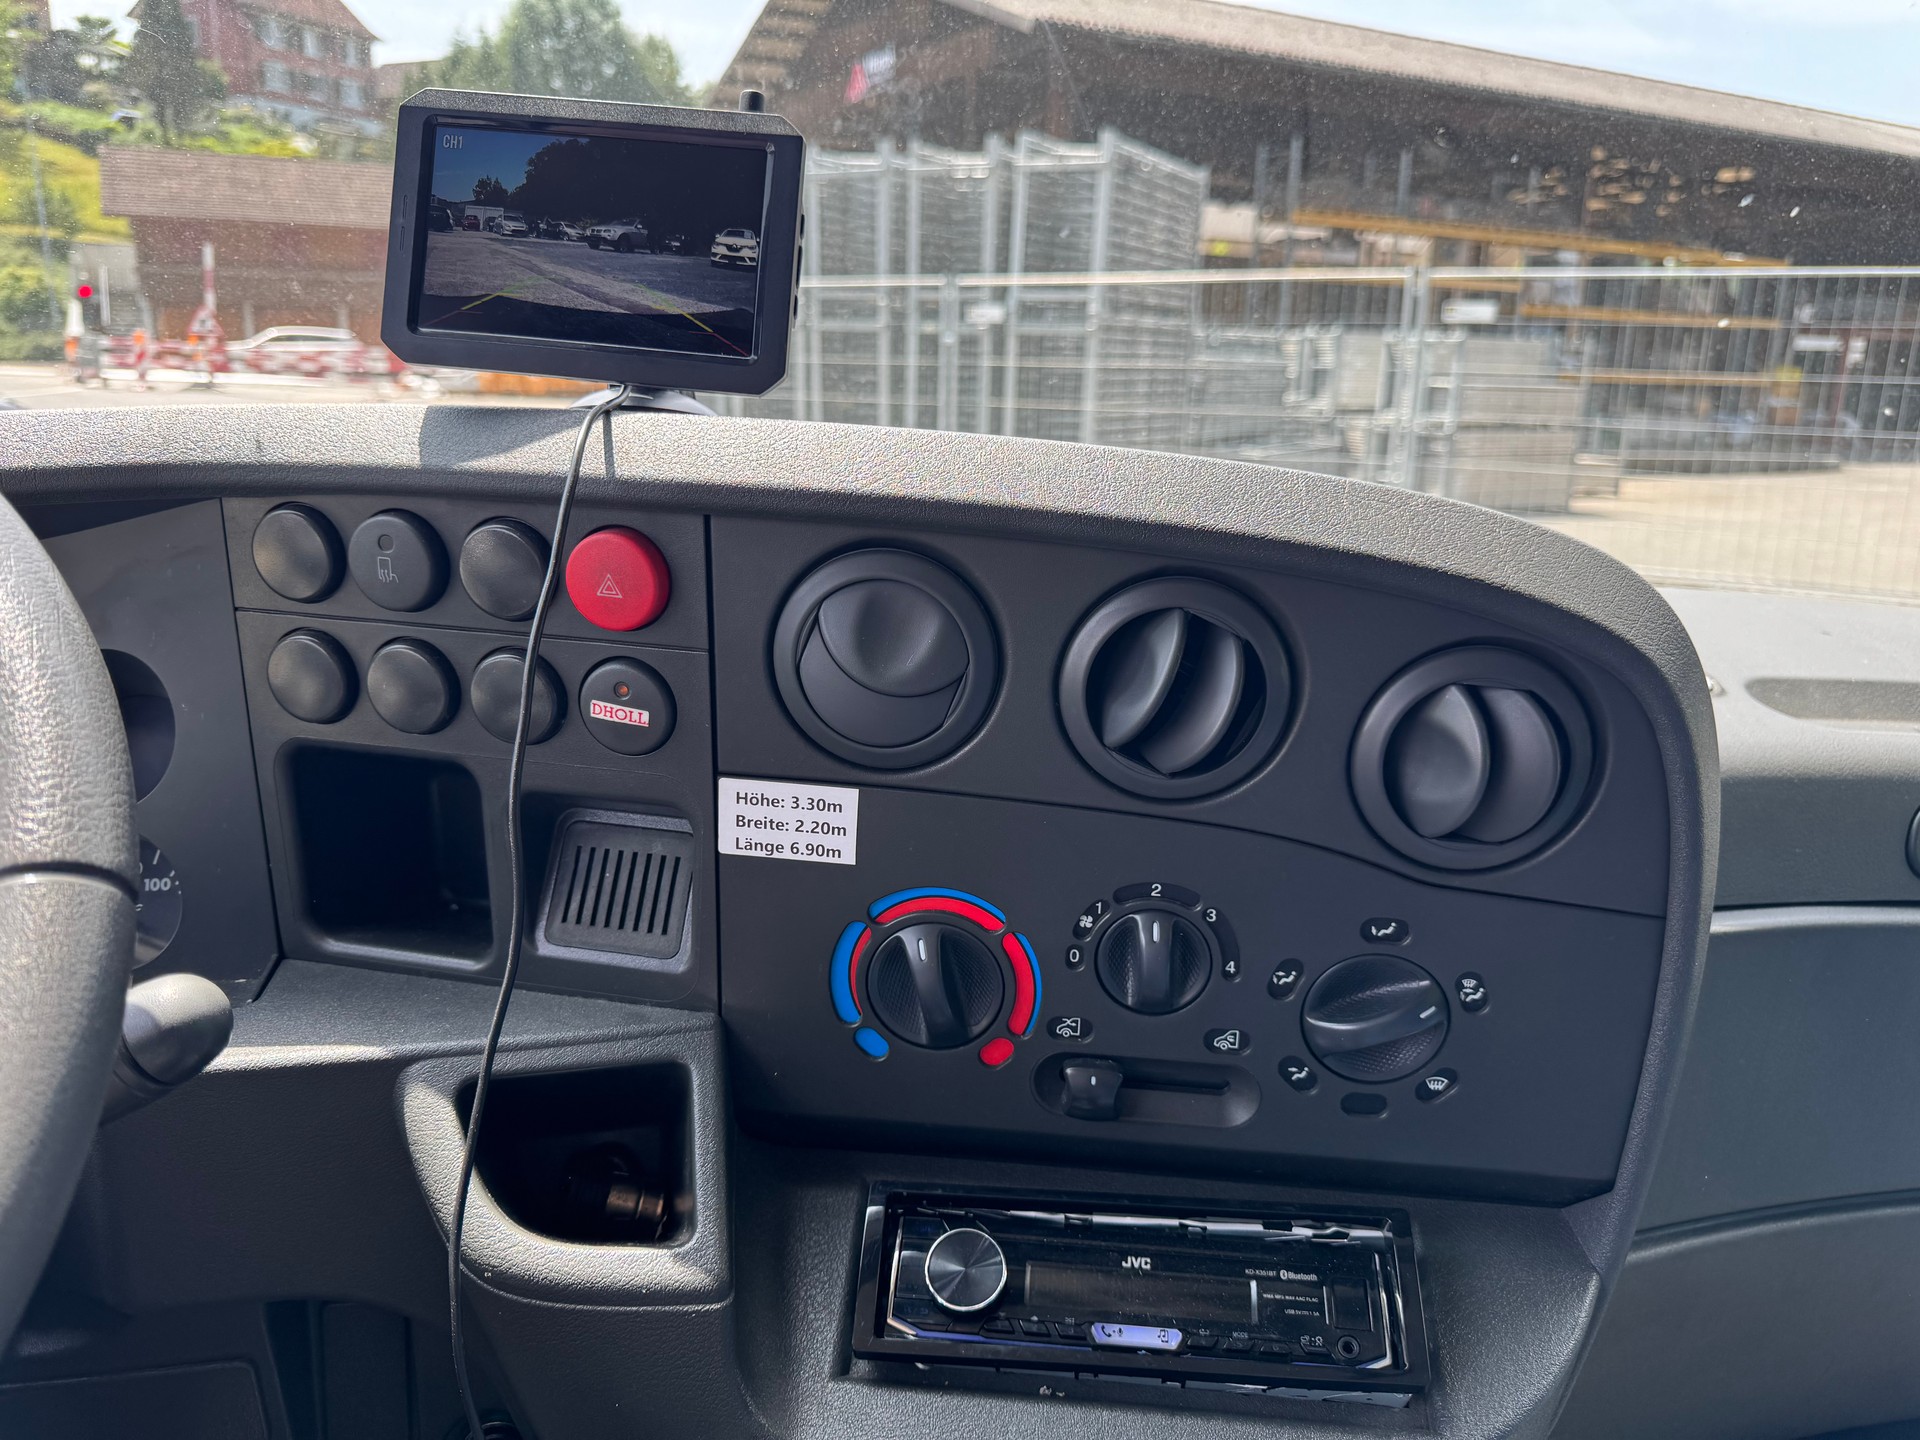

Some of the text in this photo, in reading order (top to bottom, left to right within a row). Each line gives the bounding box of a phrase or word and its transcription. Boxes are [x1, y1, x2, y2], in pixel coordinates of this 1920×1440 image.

[443, 134, 463, 149] CH1
[592, 702, 649, 726] DHOLL
[736, 791, 843, 813] Höhe: 3.30m
[735, 814, 847, 837] Breite: 2.20m
[735, 836, 842, 859] Länge 6.90m
[143, 877, 171, 892] 100
[1150, 883, 1162, 897] 2
[1095, 901, 1102, 914] 1
[1206, 908, 1217, 922] 3
[1069, 949, 1080, 963] 0
[1225, 960, 1236, 974] 4
[1121, 1255, 1151, 1270] JVC
[1287, 1270, 1318, 1281] Bluetooth
